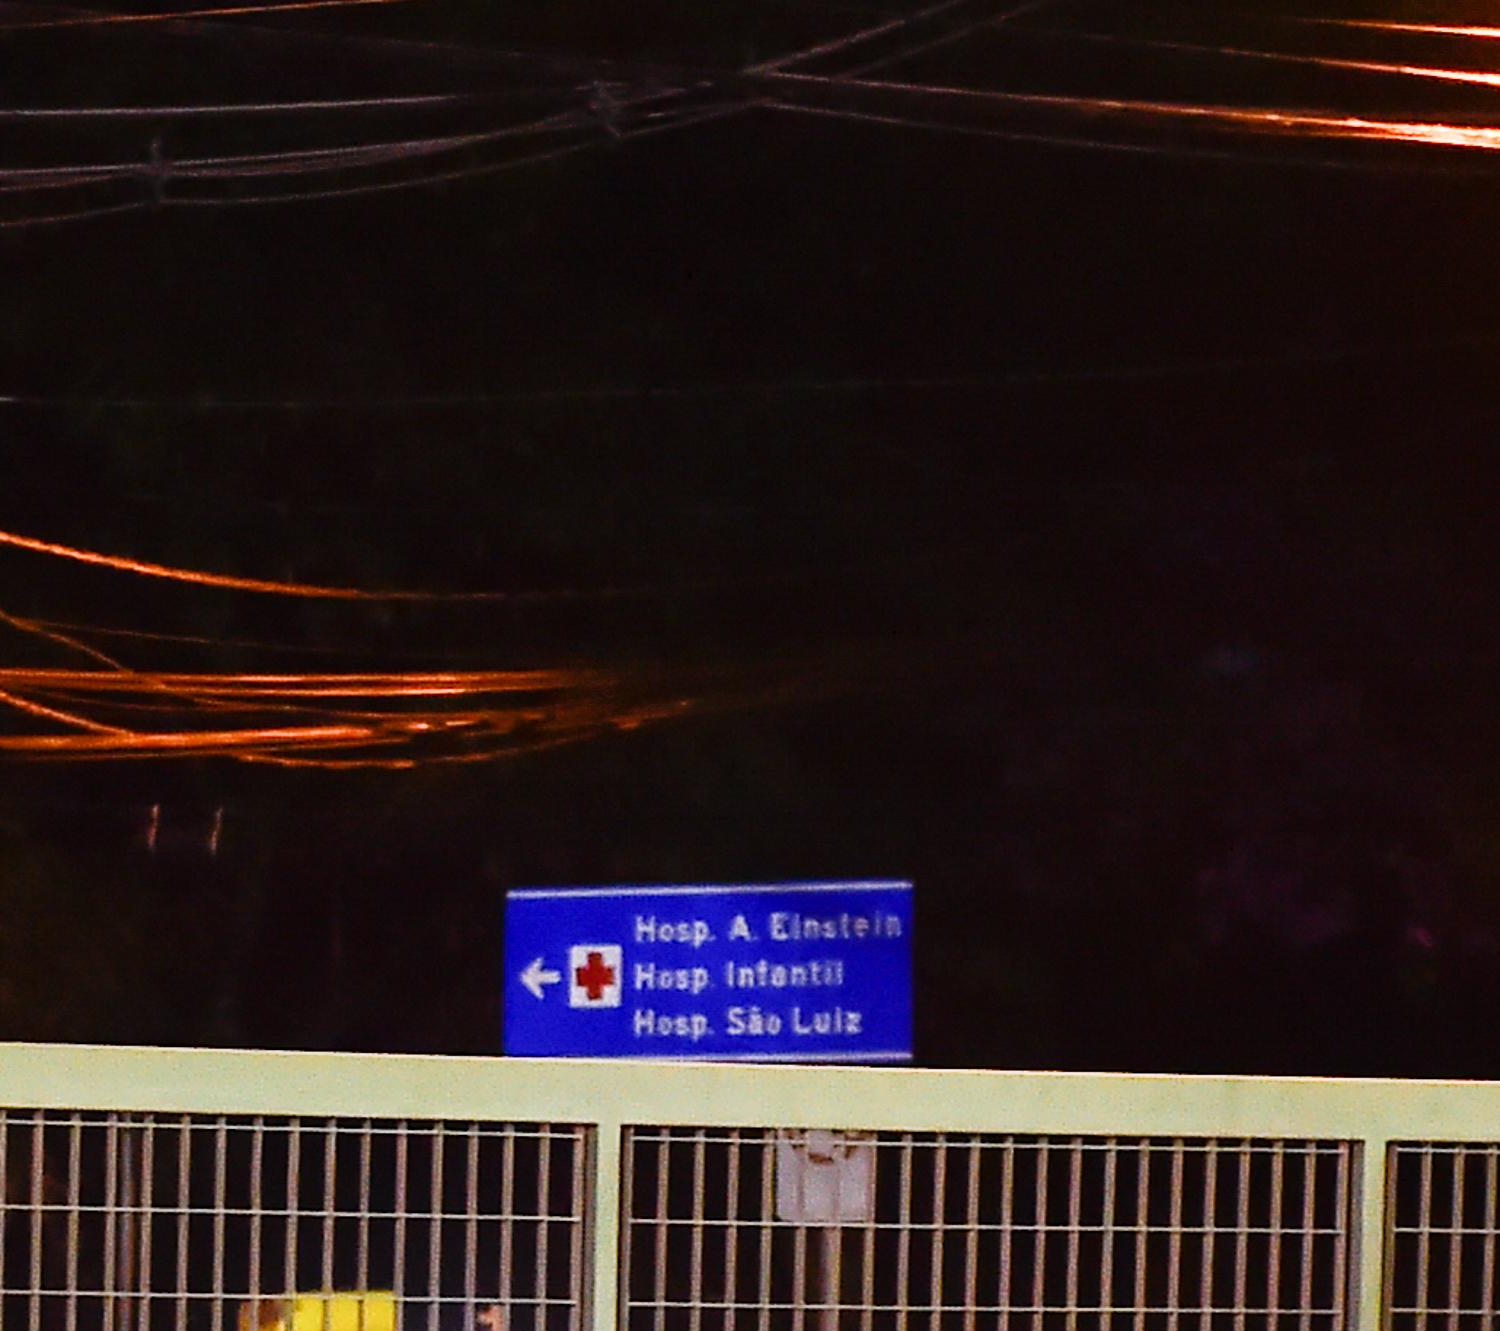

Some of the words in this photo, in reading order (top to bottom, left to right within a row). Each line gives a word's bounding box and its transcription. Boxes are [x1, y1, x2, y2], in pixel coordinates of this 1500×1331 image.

[635, 915, 716, 948] Hosp.
[729, 914, 758, 941] A.
[770, 911, 902, 940] Einstein
[727, 959, 844, 988] Infantil
[635, 1010, 714, 1041] Hosp.
[727, 1006, 782, 1036] São
[794, 1006, 862, 1034] Luiz
